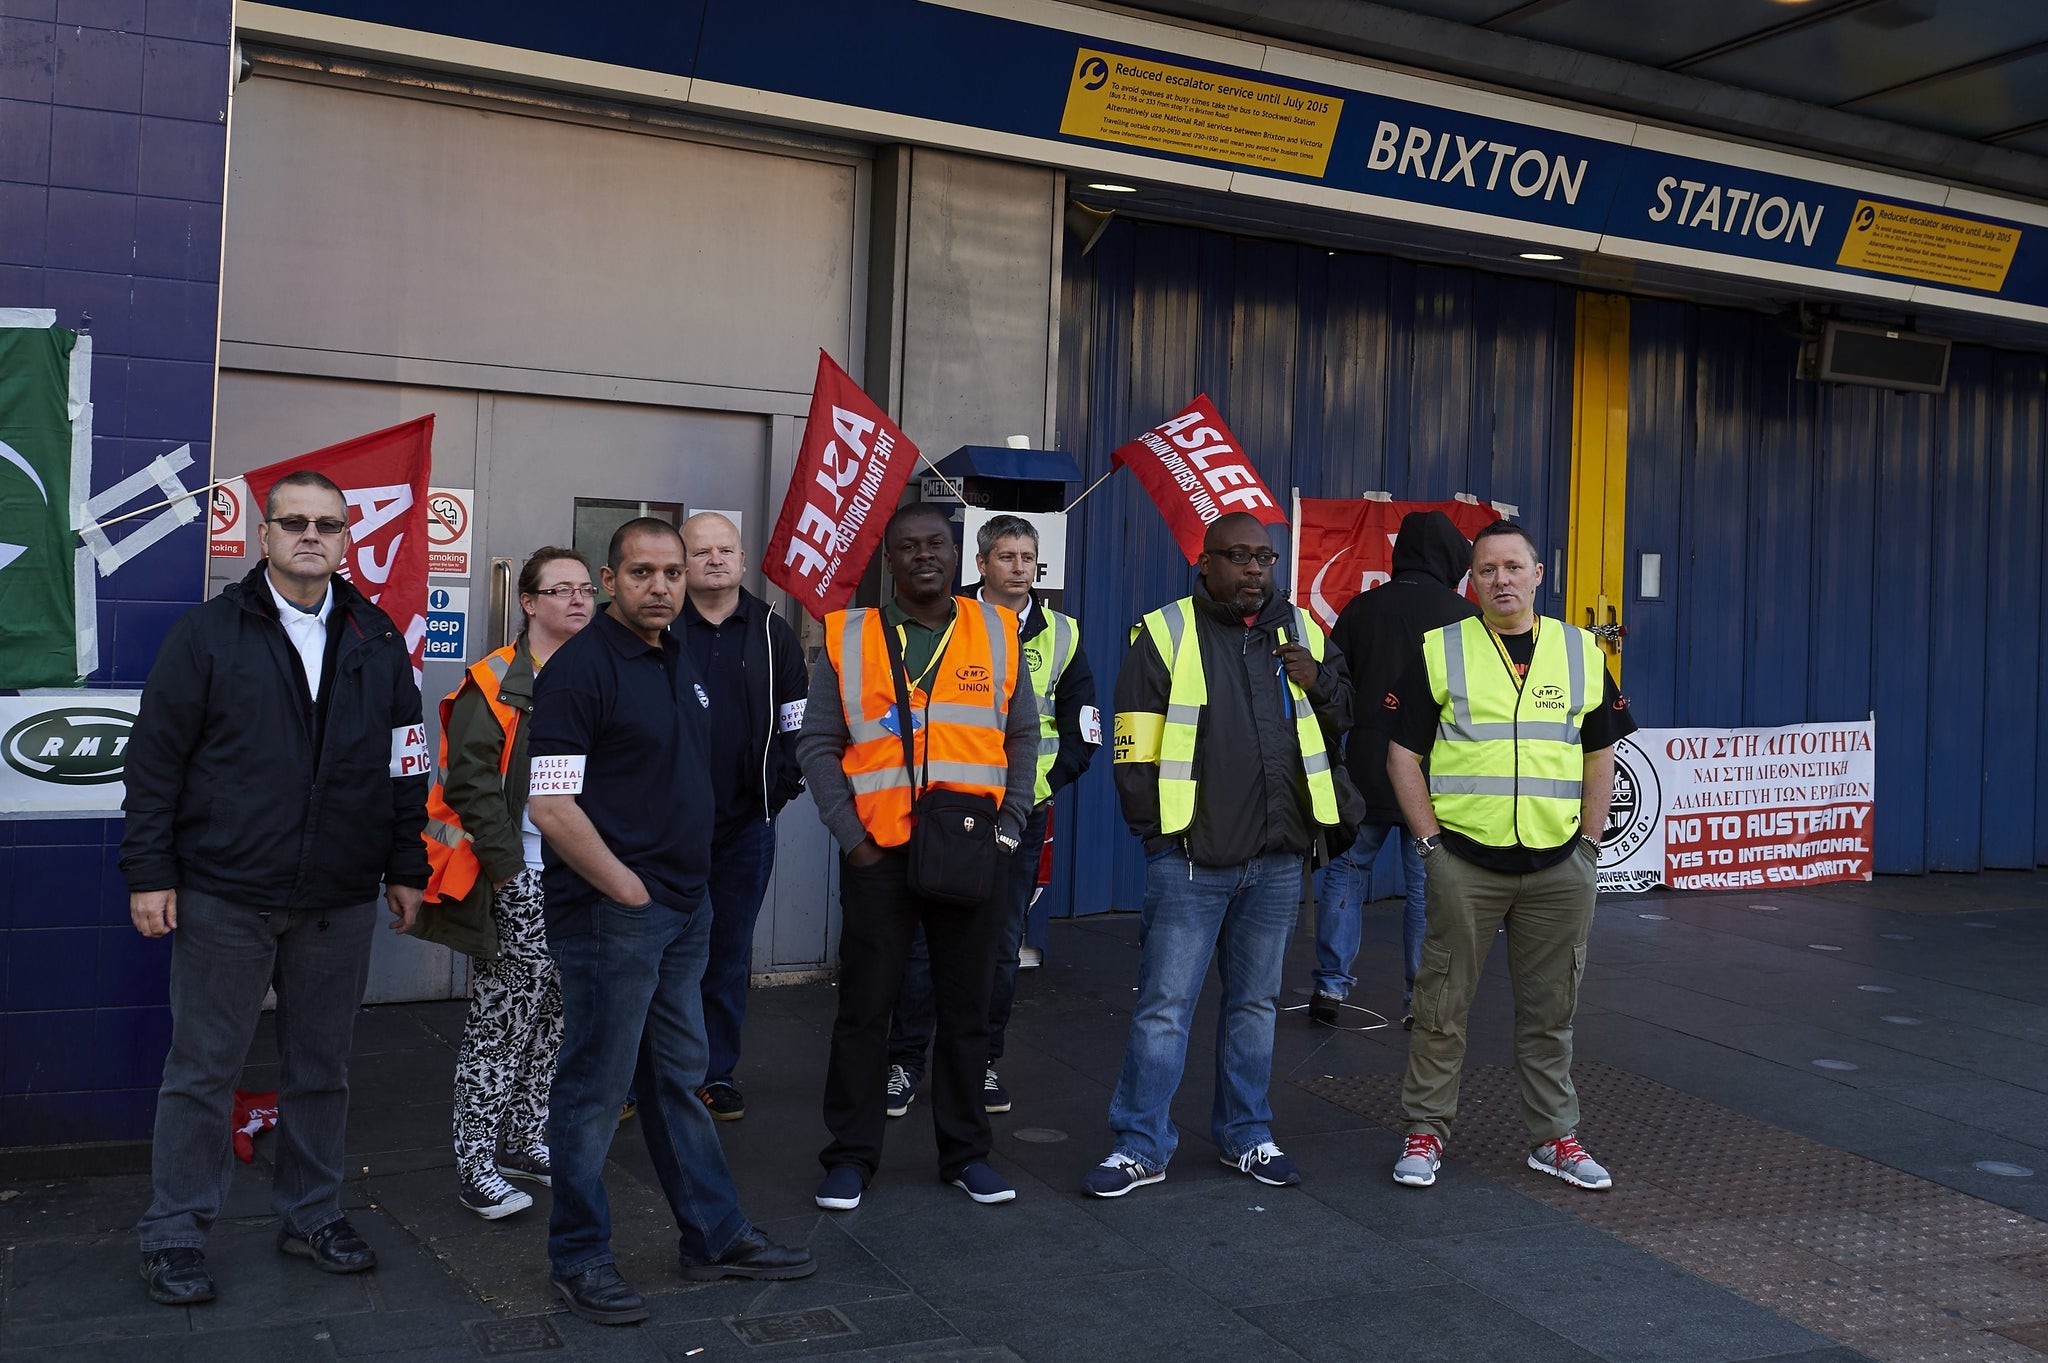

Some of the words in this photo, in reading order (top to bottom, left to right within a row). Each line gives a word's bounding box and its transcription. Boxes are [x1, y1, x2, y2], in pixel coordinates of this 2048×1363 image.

[1115, 63, 1162, 81] Reduced
[1165, 75, 1214, 91] escalator
[1217, 85, 1253, 99] service
[1256, 92, 1280, 104] until
[1283, 96, 1304, 111] July
[1306, 100, 1328, 113] 2015
[1112, 81, 1119, 90] To
[1120, 85, 1139, 93] avoid
[1140, 89, 1164, 98] queues
[1174, 94, 1190, 104] busy
[1191, 97, 1210, 106] times
[1211, 101, 1225, 109] take
[1227, 104, 1238, 112] the
[1239, 106, 1251, 114] bus
[1261, 110, 1292, 122] Stockwell
[1293, 116, 1315, 126] Station
[1103, 116, 1129, 127] Travelling
[1129, 122, 1150, 130] outside
[1280, 148, 1298, 156] busiest
[1106, 103, 1149, 118] Alternatively
[1164, 113, 1192, 124] National
[1193, 118, 1205, 127] Rail
[1206, 122, 1232, 132] services
[1233, 126, 1261, 136] between
[1263, 131, 1285, 141] Brixton
[1300, 138, 1322, 148] Victoria
[1366, 120, 1588, 205] BRIXTON
[1647, 176, 1825, 247] STATION
[1878, 209, 1909, 223] Reduced
[1909, 217, 1940, 228] escalator
[1940, 223, 1964, 233] service
[1965, 228, 1981, 237] until
[1982, 229, 1995, 241] July
[1996, 231, 2012, 243] 2015
[1142, 435, 1174, 456] TRAIN
[1155, 412, 1273, 510] ASLEF
[929, 481, 956, 496] METRO
[429, 553, 465, 563] smoking
[958, 684, 990, 692] UNION
[1535, 701, 1565, 709] UNION
[38, 736, 130, 757] RMT
[1666, 737, 1709, 761] ΟΧΙ
[1712, 735, 1760, 758] ΣΤΗ
[1762, 730, 1872, 756] ΛΙΤΟΤΗΤΑ
[538, 759, 569, 768] ASLEF
[1694, 767, 1718, 783] ΝΑΙ
[1723, 766, 1753, 782] ΣΤΗ
[1756, 760, 1848, 780] ΔΙΕΘΝΙΣΤΙΚΗ
[531, 782, 578, 791] PICKET
[1774, 787, 1806, 802] ΤΩΝ
[1811, 782, 1870, 800] ΕΡΓΑΤΩΝ
[1668, 818, 1702, 844] NO
[1707, 815, 1741, 840] TO
[1747, 806, 1870, 838] AUSTERITY
[1667, 851, 1703, 870] YES
[1708, 850, 1734, 865] TO
[1738, 837, 1870, 864] INTERNATIONAL
[1630, 870, 1661, 882] UNION
[1673, 869, 1764, 890] WORKERS
[1767, 859, 1863, 882] SOLIDARITY
